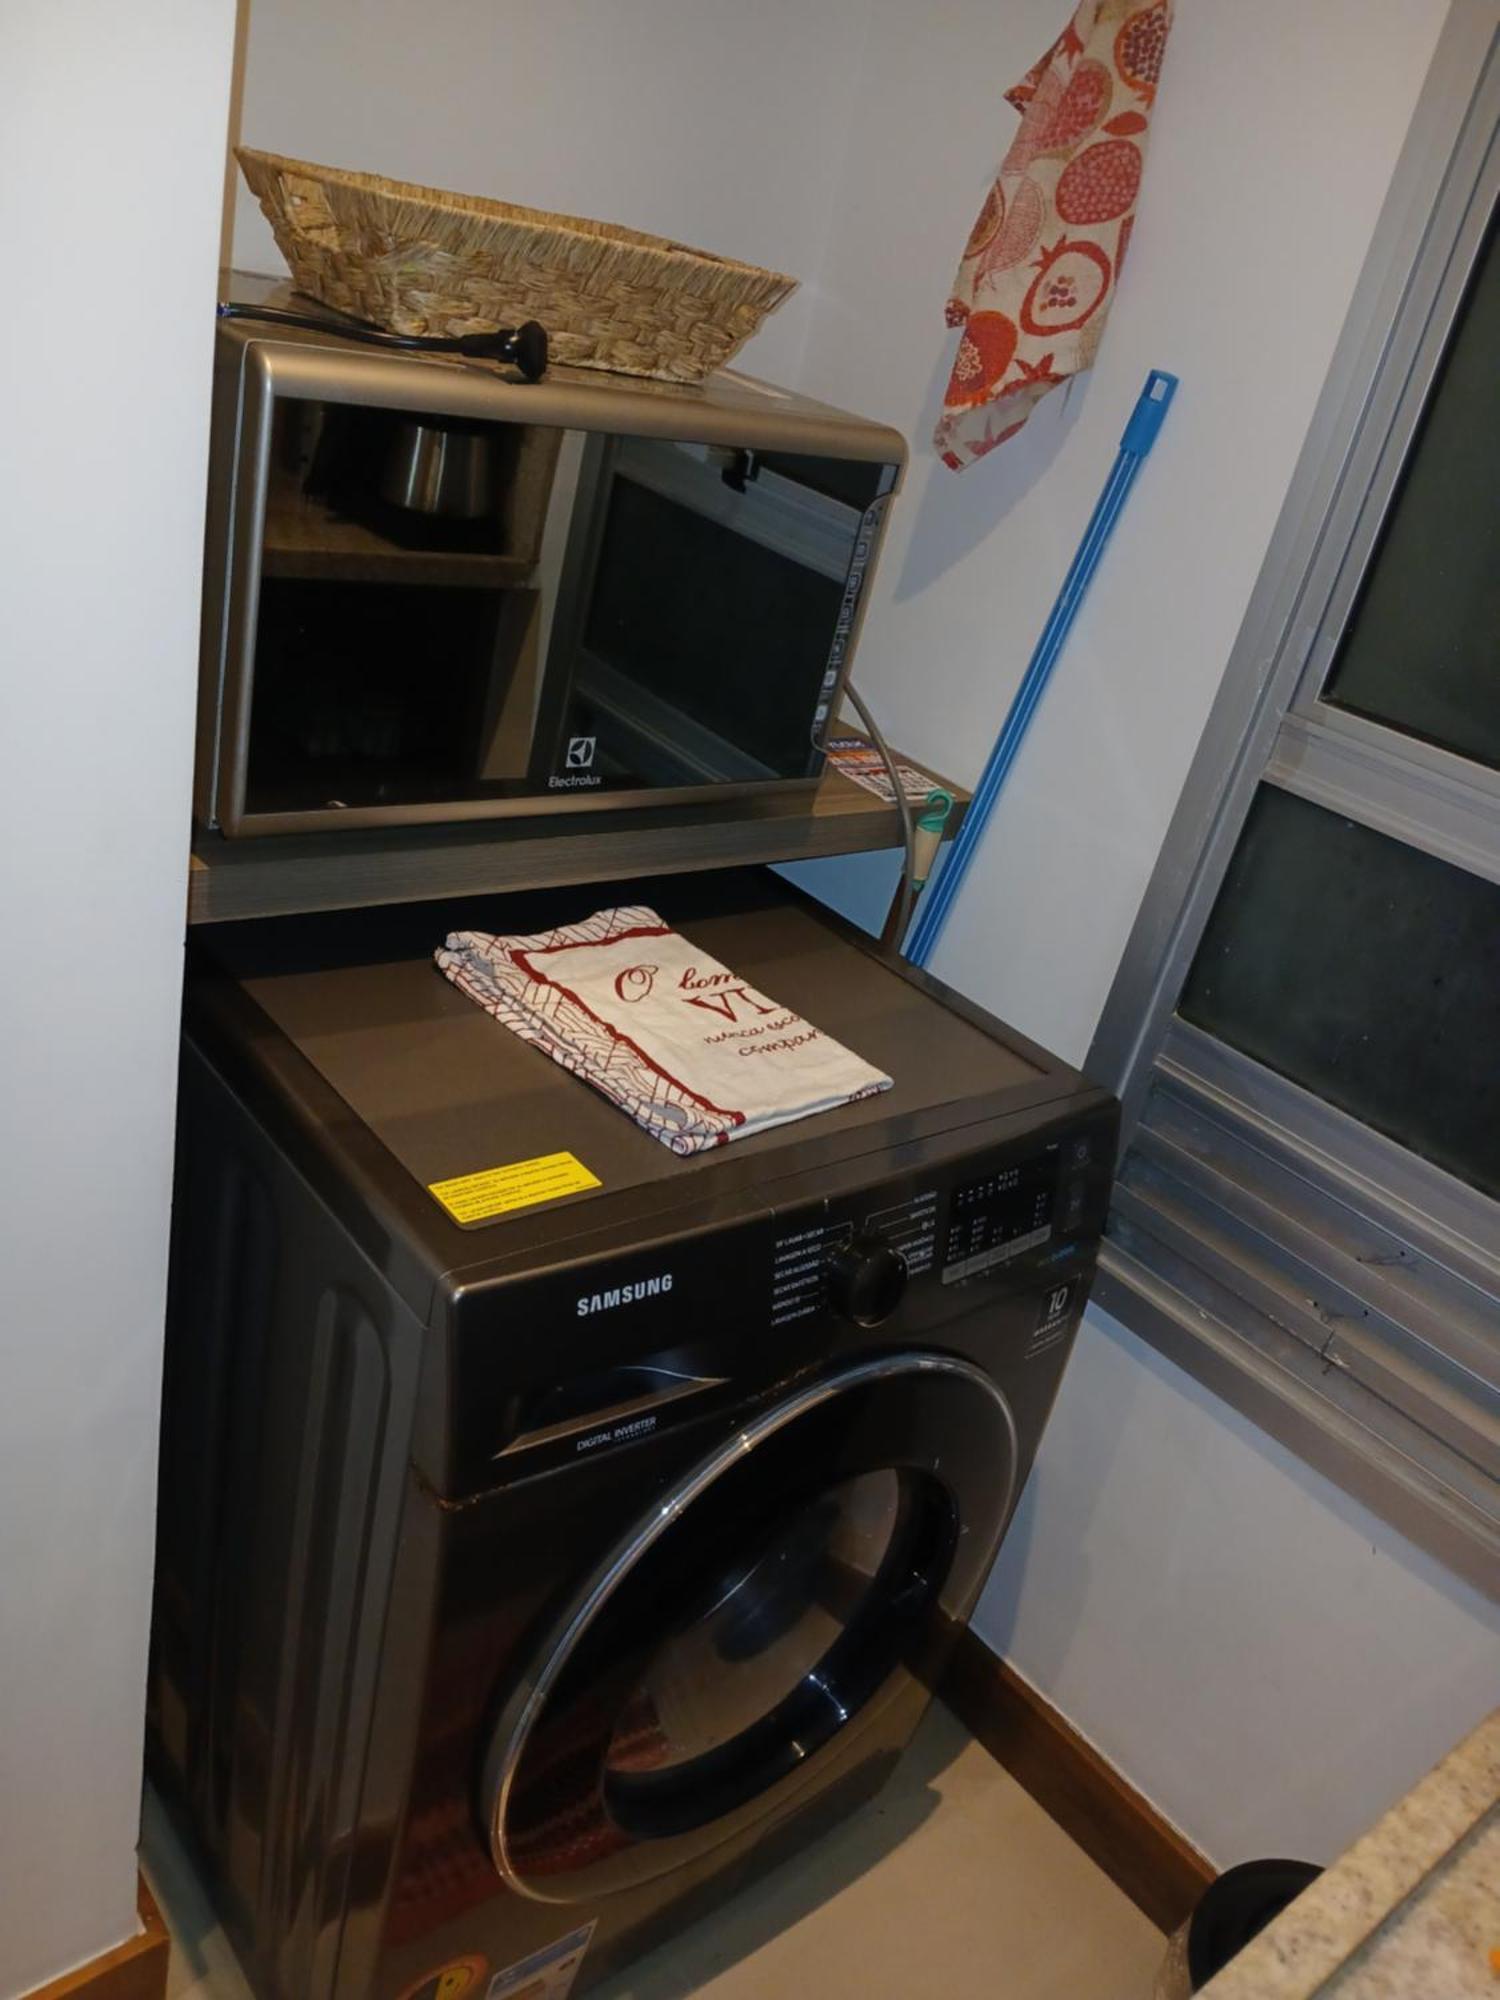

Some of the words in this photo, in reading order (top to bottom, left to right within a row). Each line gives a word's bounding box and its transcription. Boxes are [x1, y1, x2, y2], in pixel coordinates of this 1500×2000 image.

[548, 774, 603, 788] Electrolux
[577, 1273, 673, 1317] SAMSUNG
[1049, 1286, 1069, 1314] 10
[576, 1431, 612, 1452] DIGITAL
[614, 1416, 657, 1438] INVERTER
